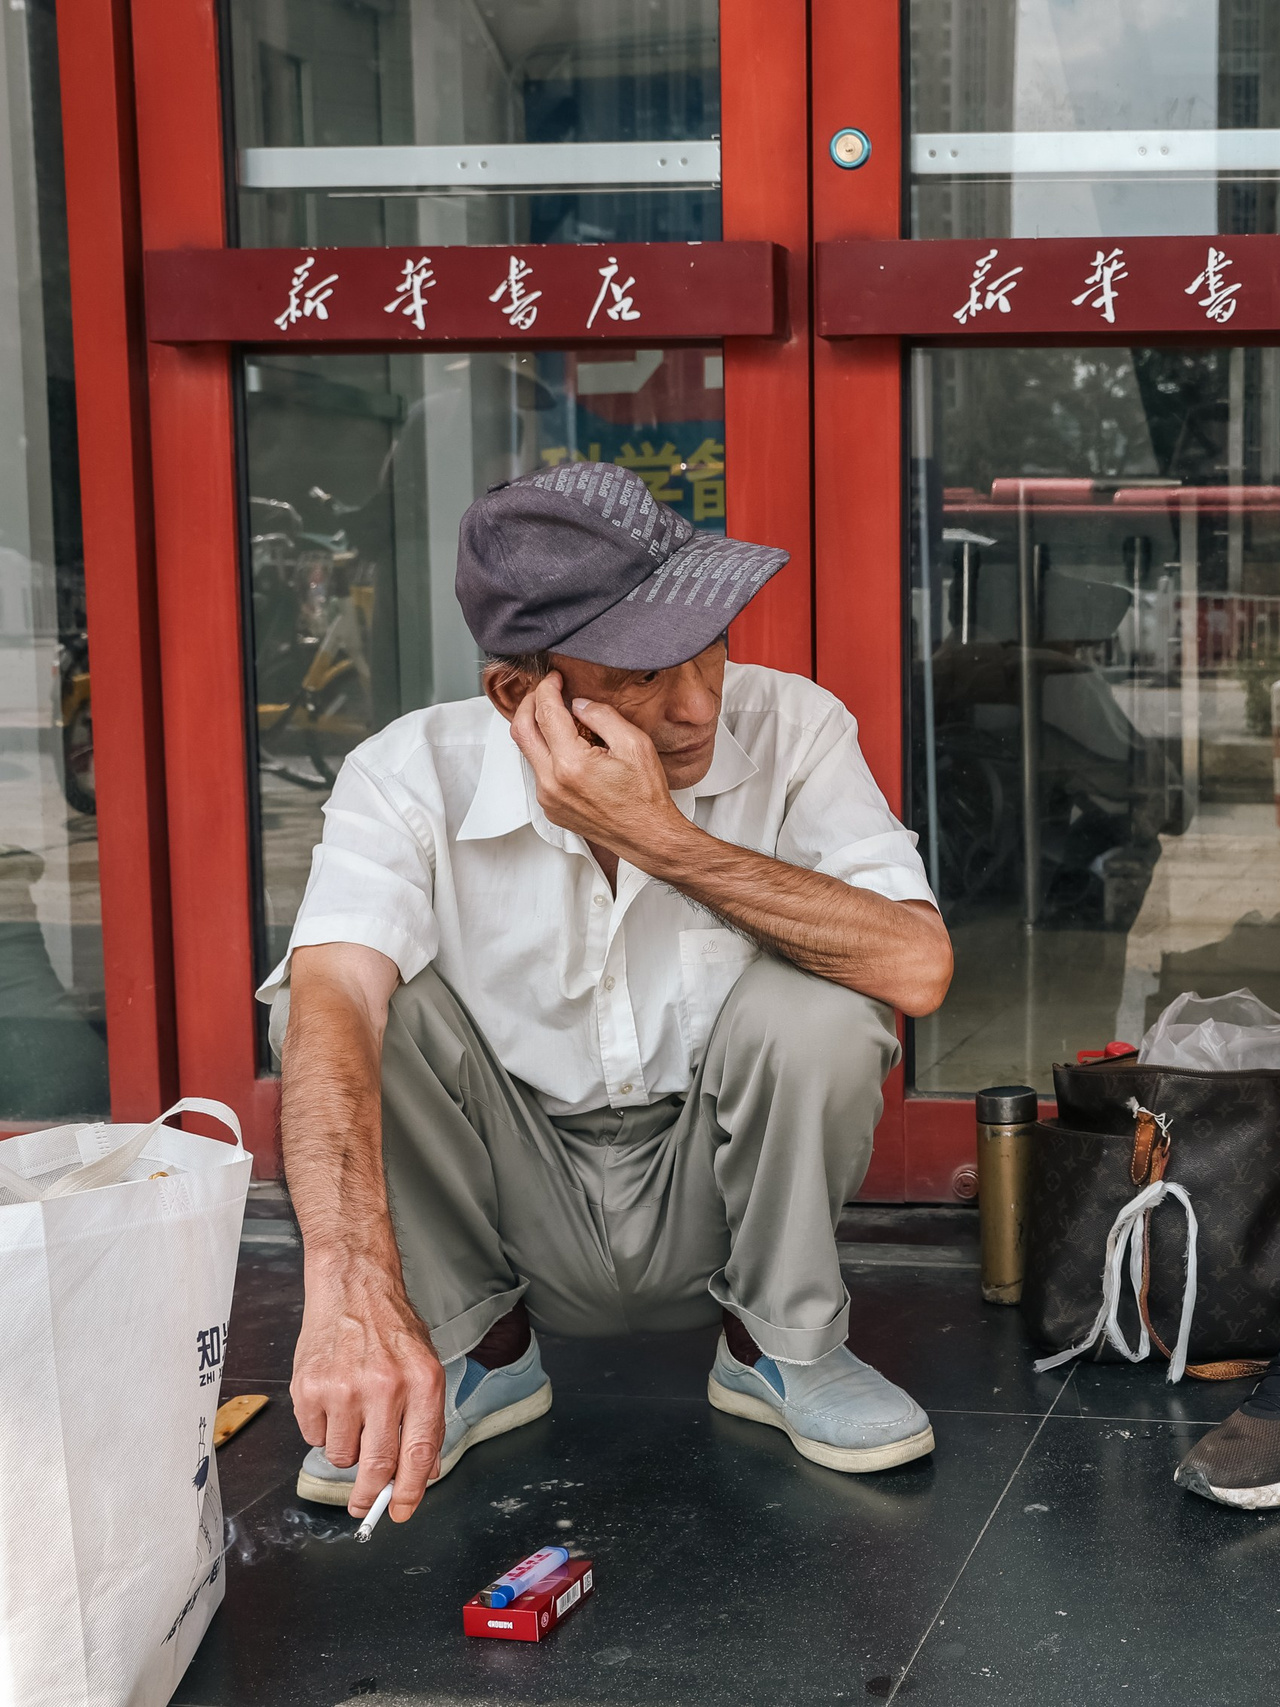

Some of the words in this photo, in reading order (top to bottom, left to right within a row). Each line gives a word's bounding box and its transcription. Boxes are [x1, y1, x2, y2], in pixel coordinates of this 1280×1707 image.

[599, 472, 614, 498] SPORTS
[619, 479, 635, 507] SPORTS
[692, 551, 722, 578] SPORTS
[711, 553, 741, 580] SPORTS
[731, 556, 761, 581] SPORTS
[199, 1371, 216, 1388] ZHI
